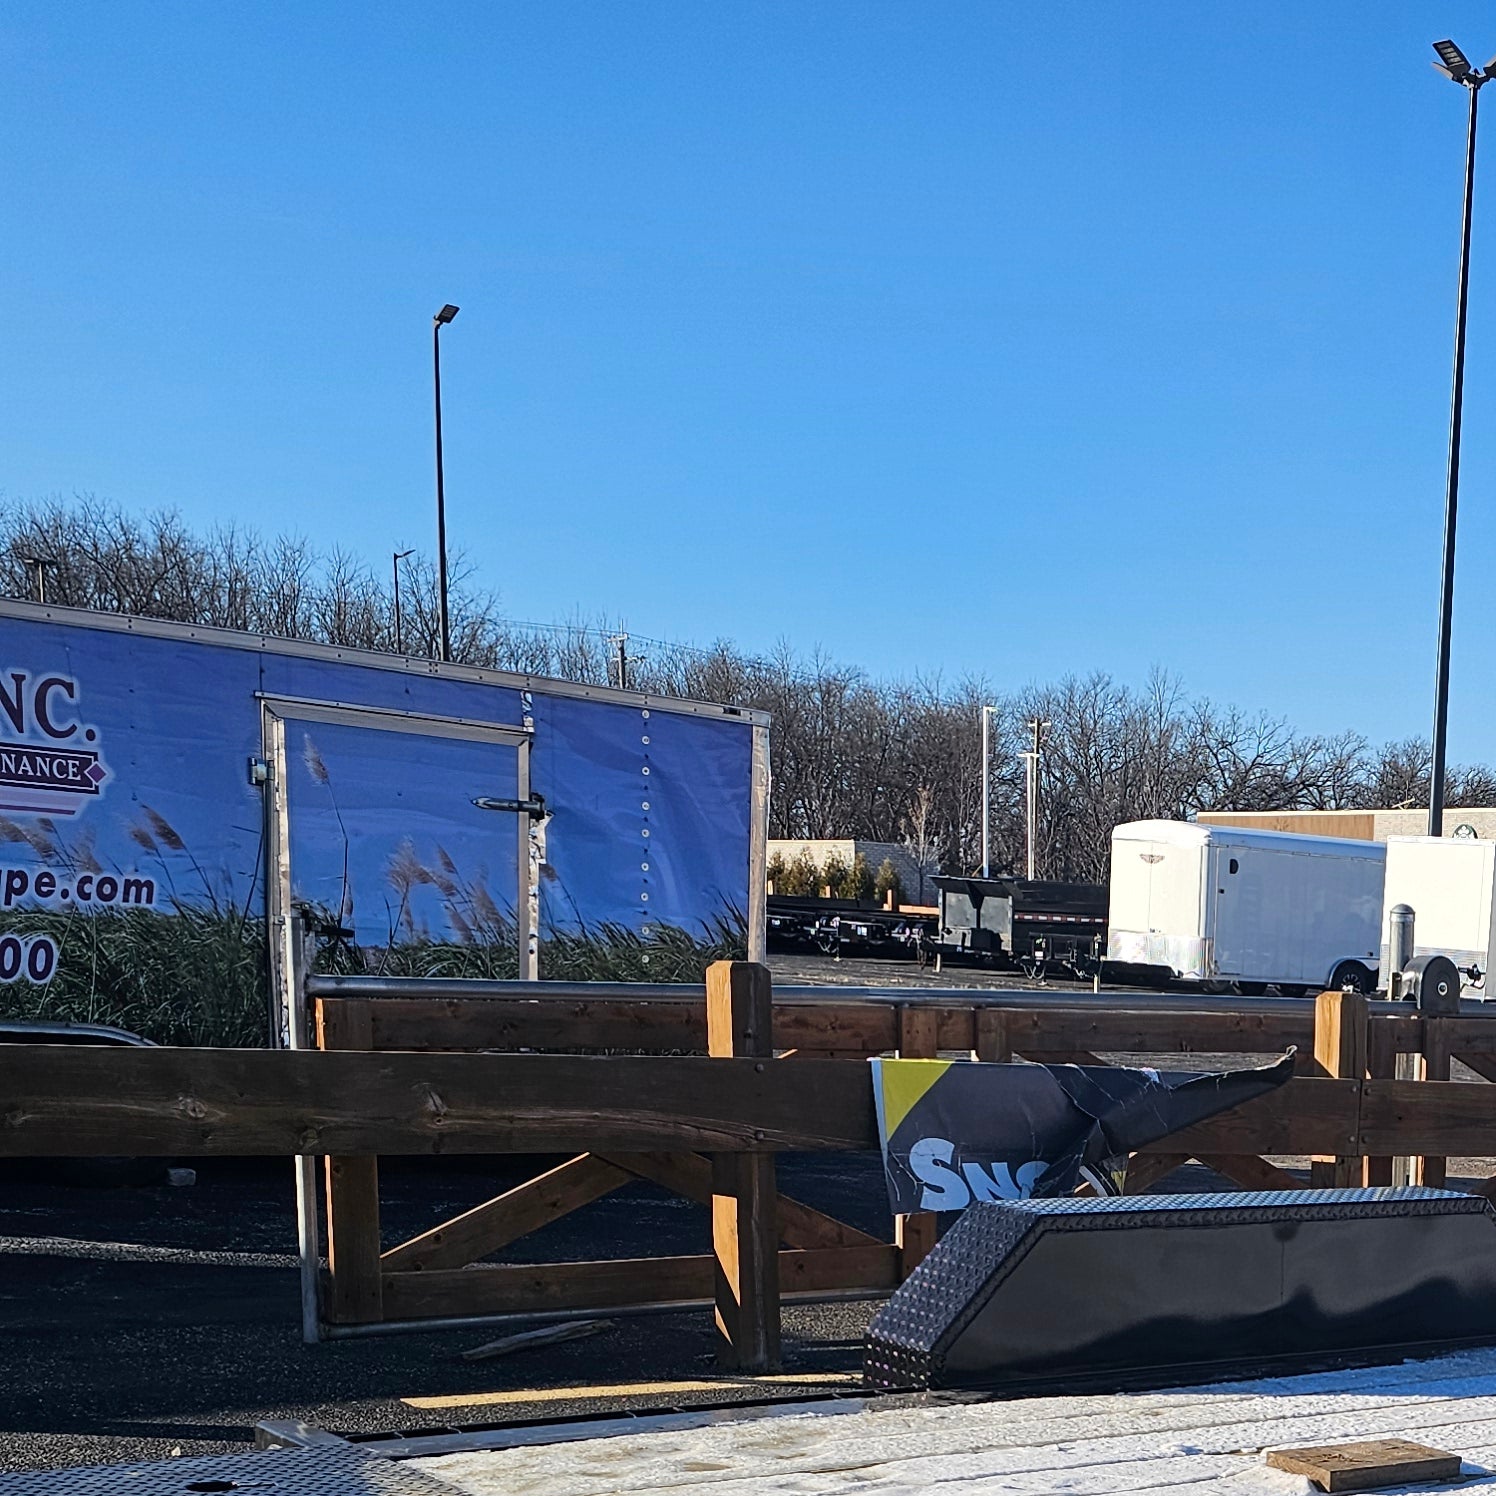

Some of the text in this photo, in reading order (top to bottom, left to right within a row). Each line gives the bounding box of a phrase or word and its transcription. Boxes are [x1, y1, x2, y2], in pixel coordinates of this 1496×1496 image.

[1, 753, 82, 781] NANCE
[0, 869, 155, 906] pe.com
[0, 937, 54, 981] 00
